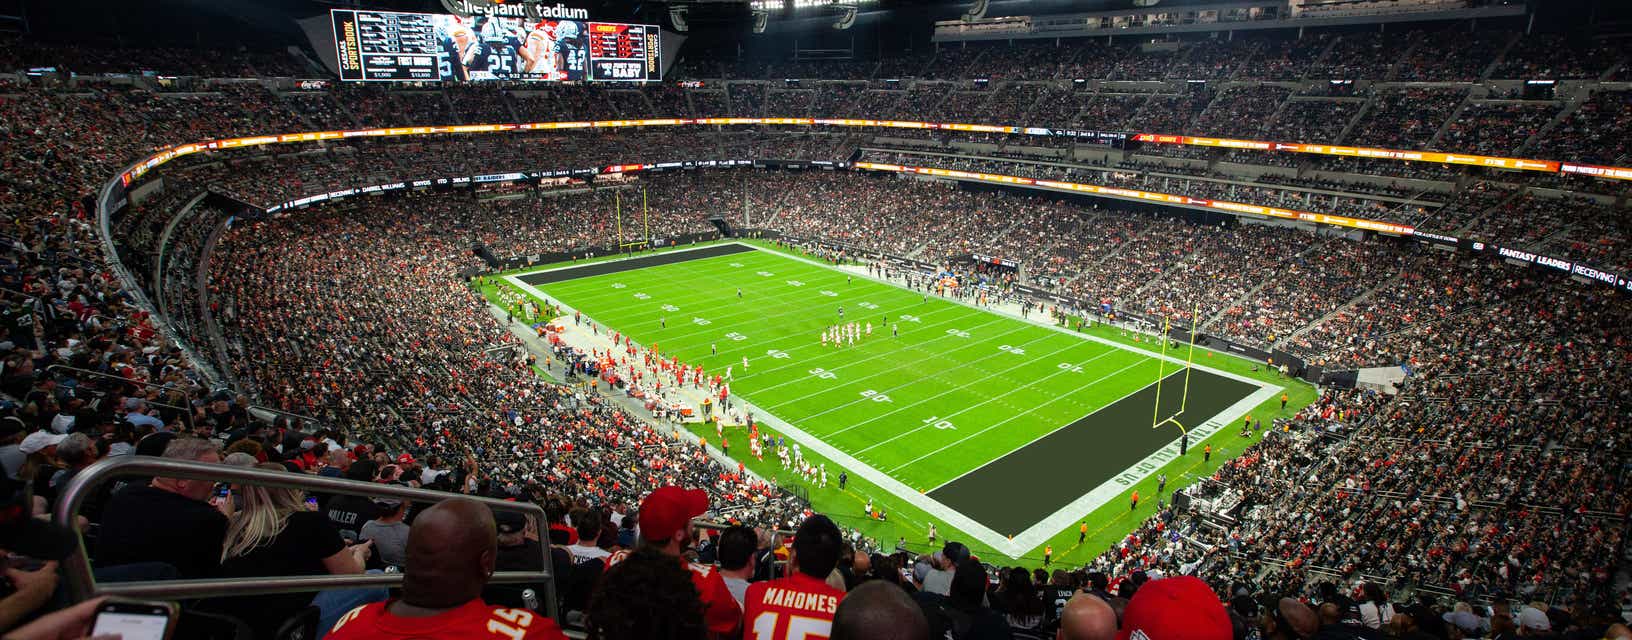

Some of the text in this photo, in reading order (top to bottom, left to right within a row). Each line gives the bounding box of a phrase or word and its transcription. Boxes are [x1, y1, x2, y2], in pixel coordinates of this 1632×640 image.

[344, 22, 359, 70] SPORTSBOOK
[1499, 247, 1615, 284] FANTASY LEADERS RECEIVING
[808, 367, 834, 379] 30
[859, 389, 889, 402] 20
[922, 416, 952, 429] 10
[1136, 462, 1156, 475] OF
[1114, 472, 1138, 486] US
[762, 587, 838, 613] MAHOMES
[487, 608, 534, 640] 15
